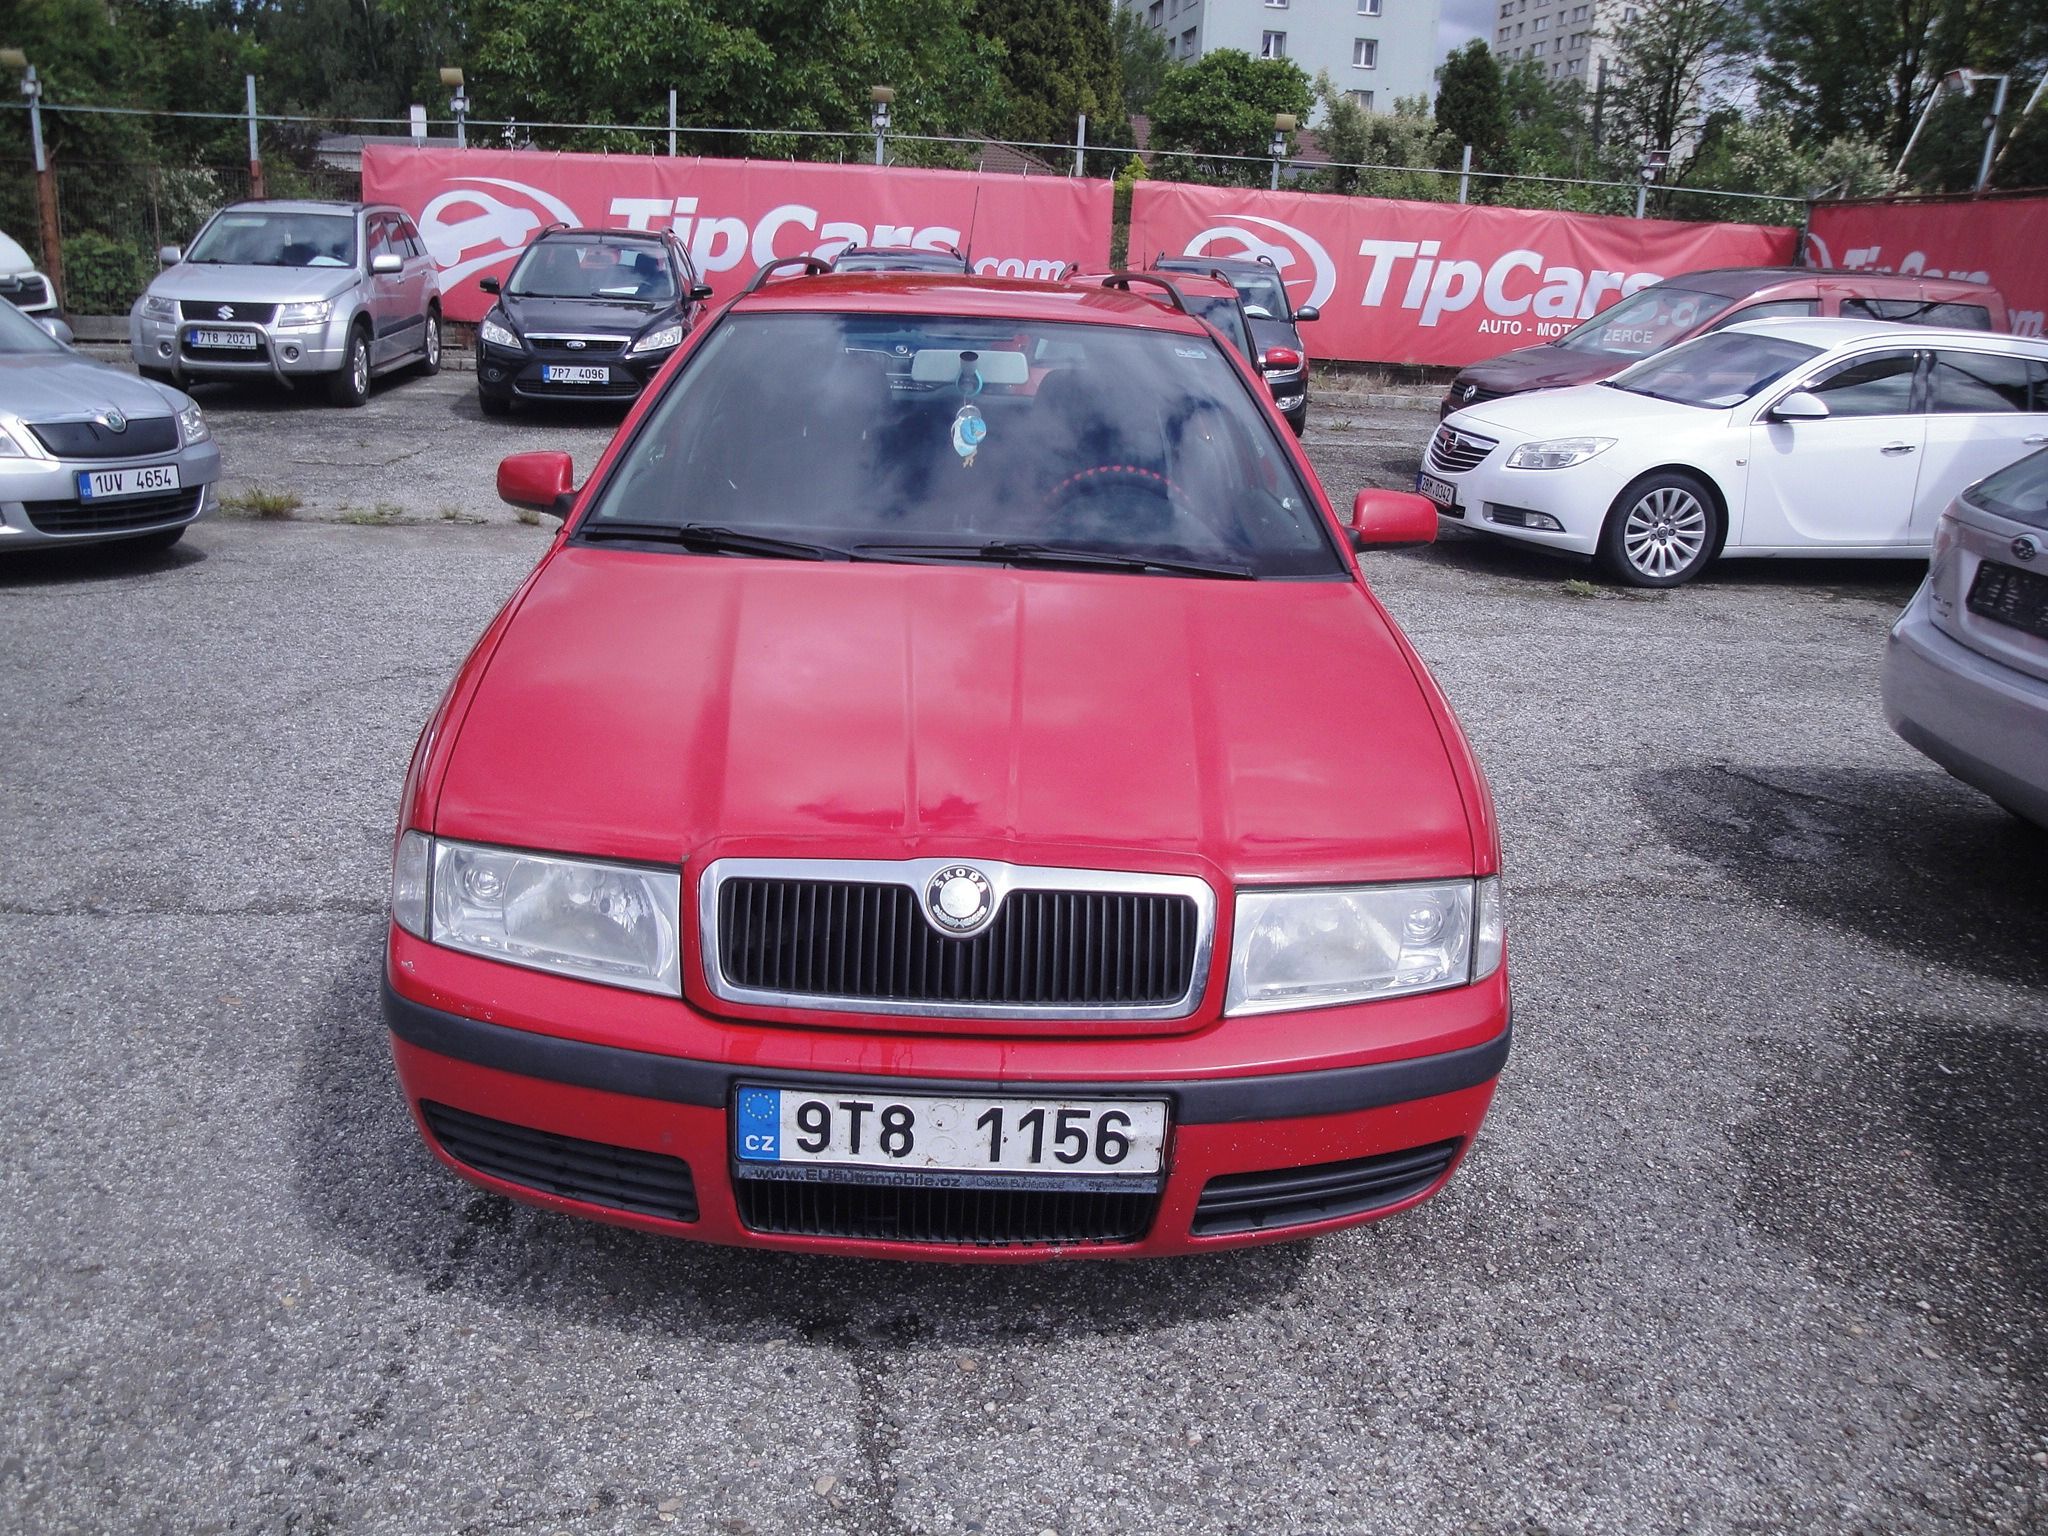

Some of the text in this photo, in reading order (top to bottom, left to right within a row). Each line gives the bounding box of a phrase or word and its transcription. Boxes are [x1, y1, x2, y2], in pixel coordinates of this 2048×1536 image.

[1478, 319, 1522, 335] AUTO
[200, 332, 251, 344] 7T8 2021
[551, 367, 604, 379] 7P7 4096
[95, 469, 172, 493] 1UV 4654
[796, 1100, 1132, 1165] 9T8 1156
[745, 1134, 775, 1152] CZ
